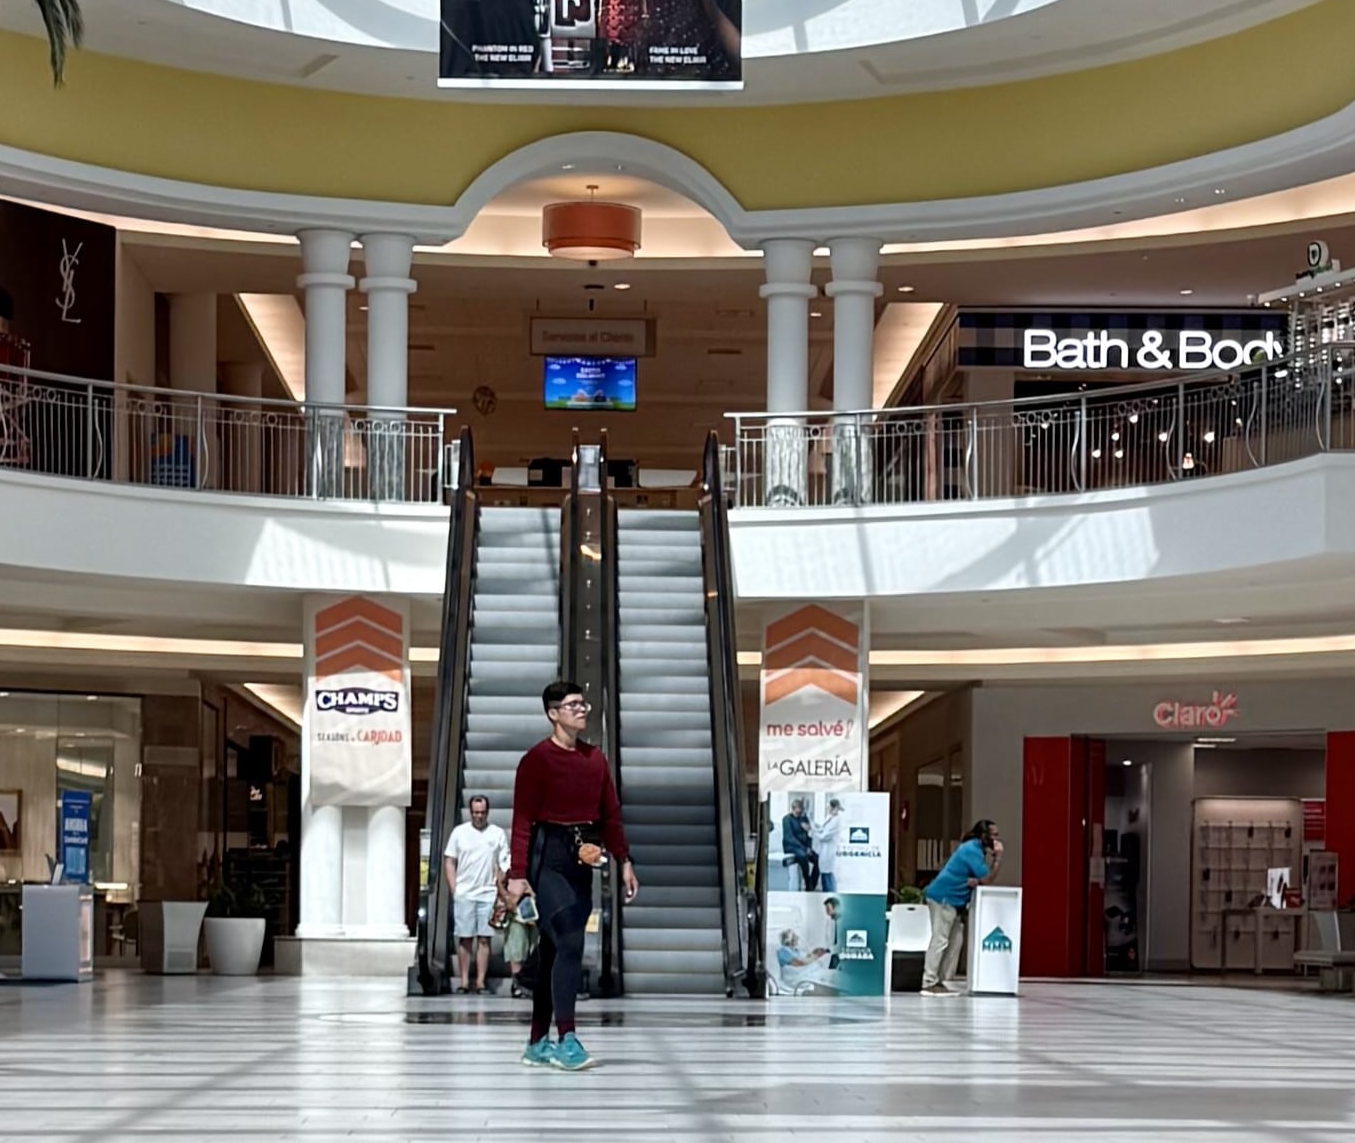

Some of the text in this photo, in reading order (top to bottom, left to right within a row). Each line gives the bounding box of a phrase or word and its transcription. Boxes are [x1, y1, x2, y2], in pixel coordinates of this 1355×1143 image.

[1023, 329, 1129, 369] Bath
[1136, 330, 1173, 370] &
[317, 691, 398, 710] CHAMPS
[1153, 702, 1222, 727] Claro
[767, 724, 793, 736] me
[779, 755, 852, 776] GALERÍA
